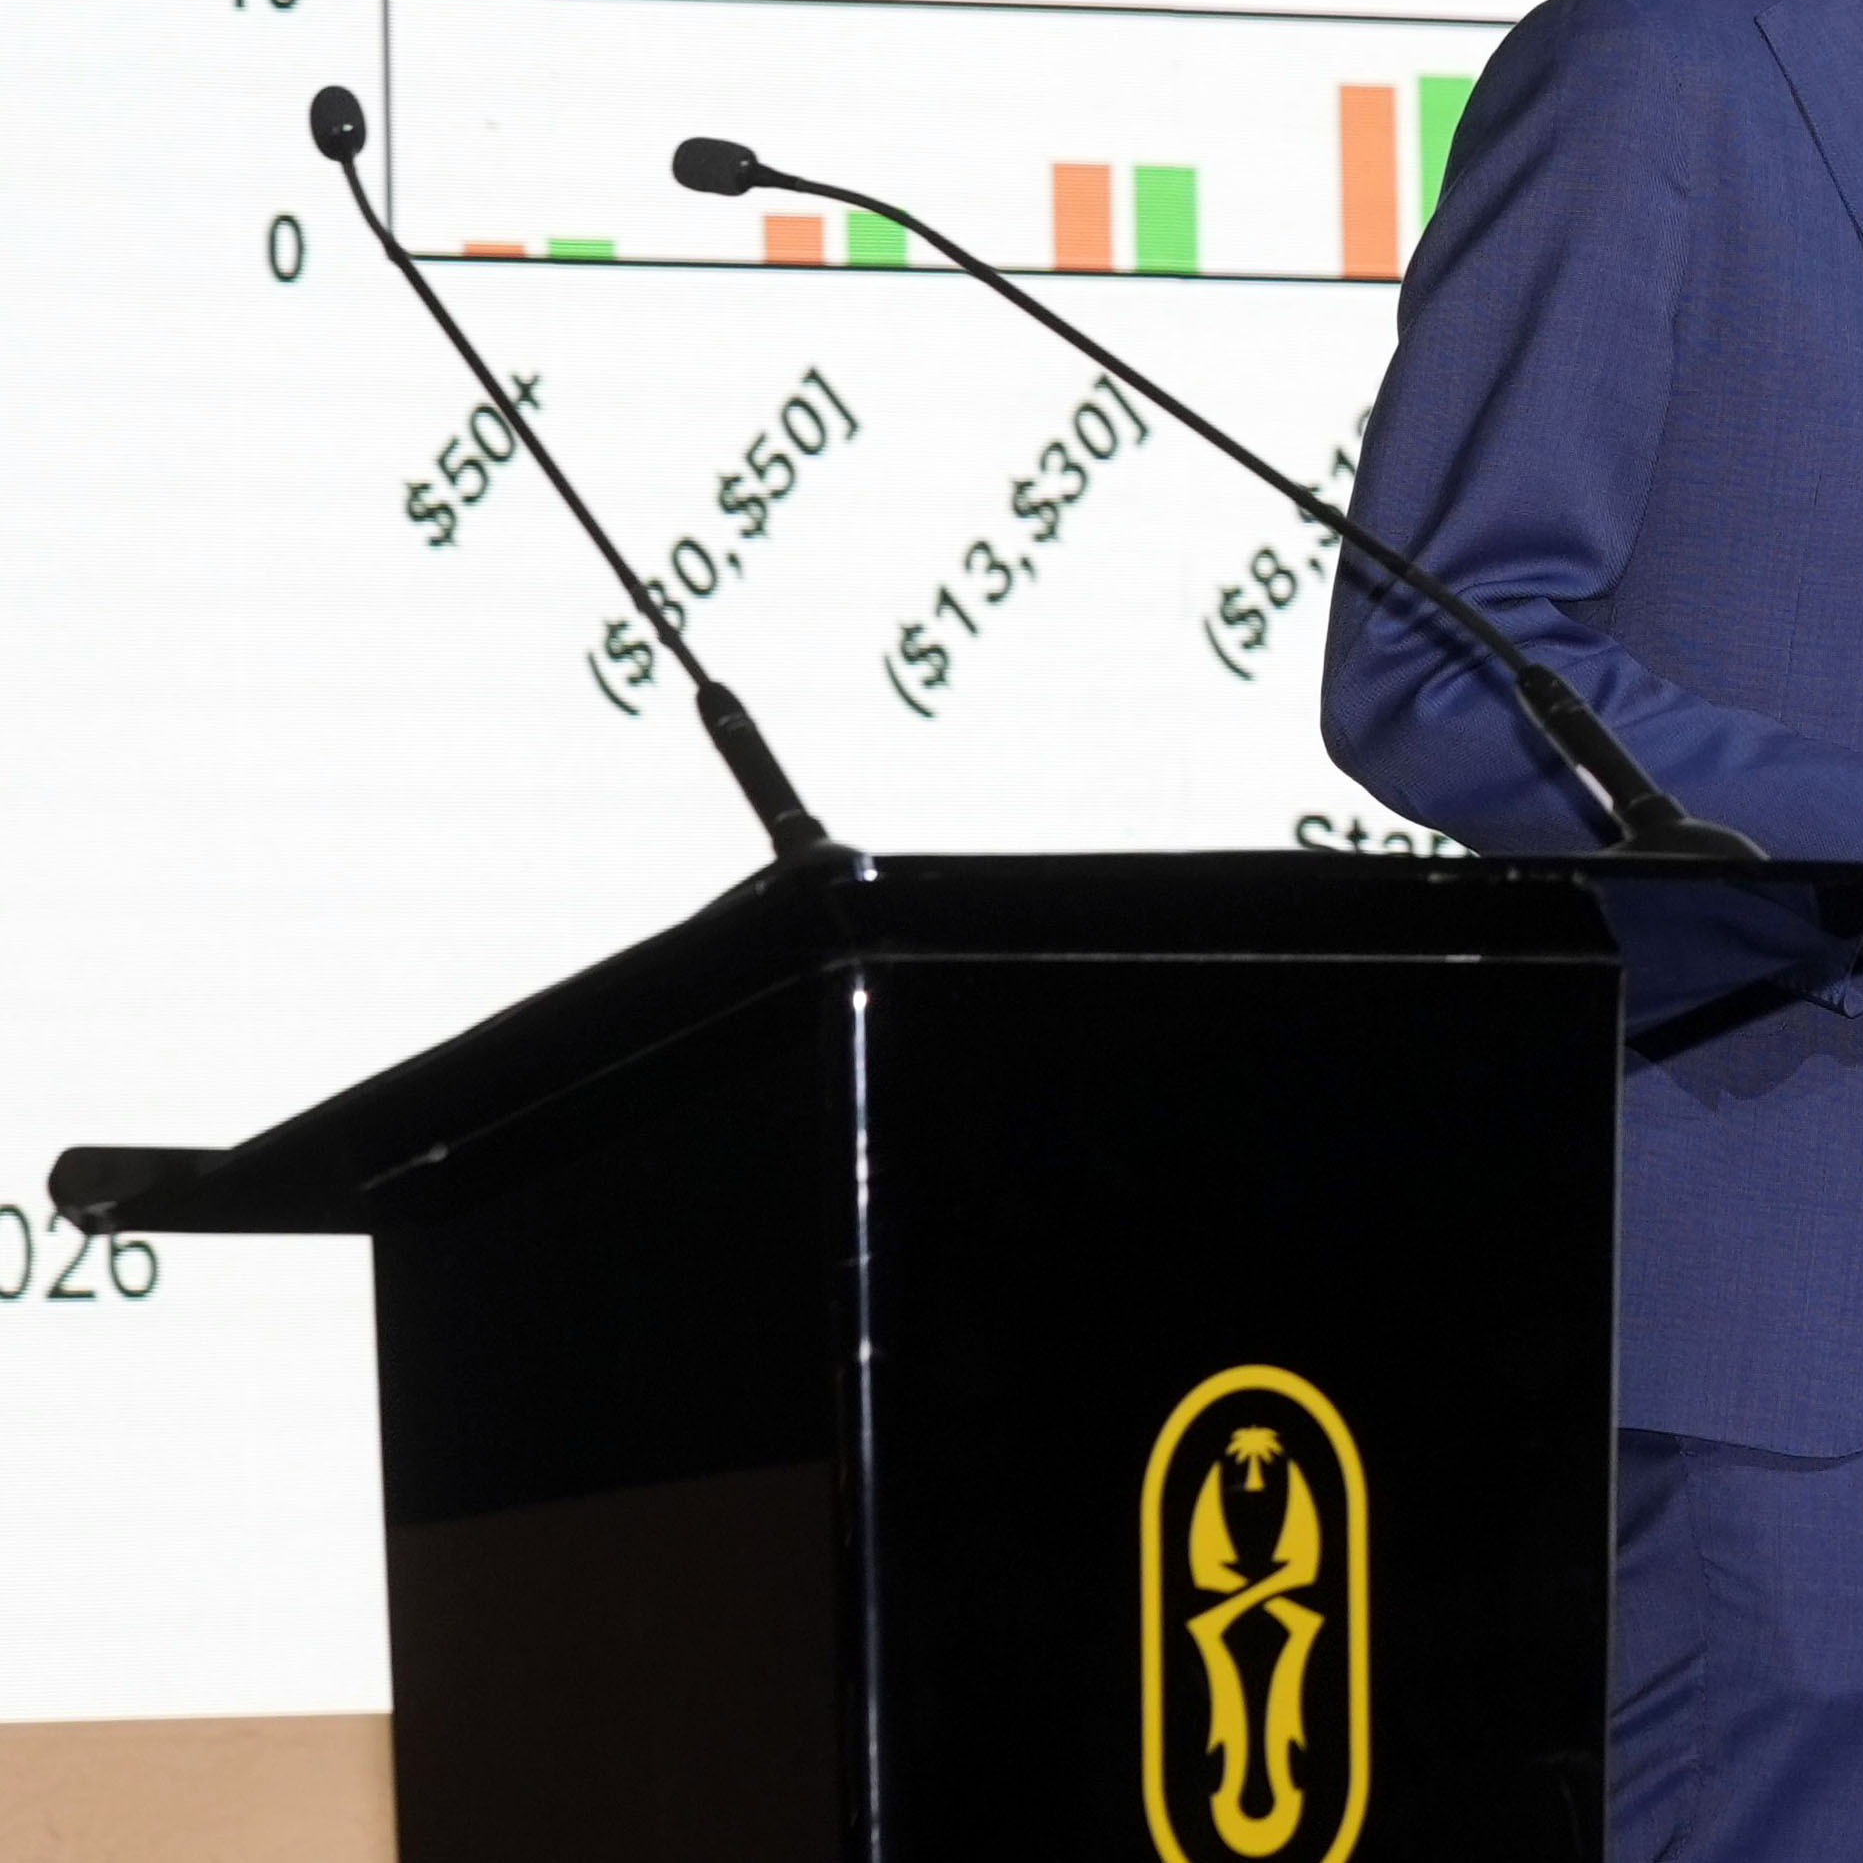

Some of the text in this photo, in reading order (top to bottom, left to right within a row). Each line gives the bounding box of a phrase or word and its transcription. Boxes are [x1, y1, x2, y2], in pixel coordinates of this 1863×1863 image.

[267, 214, 306, 283] 0
[405, 372, 541, 547] $50+
[883, 372, 1150, 717] ($13,$30]
